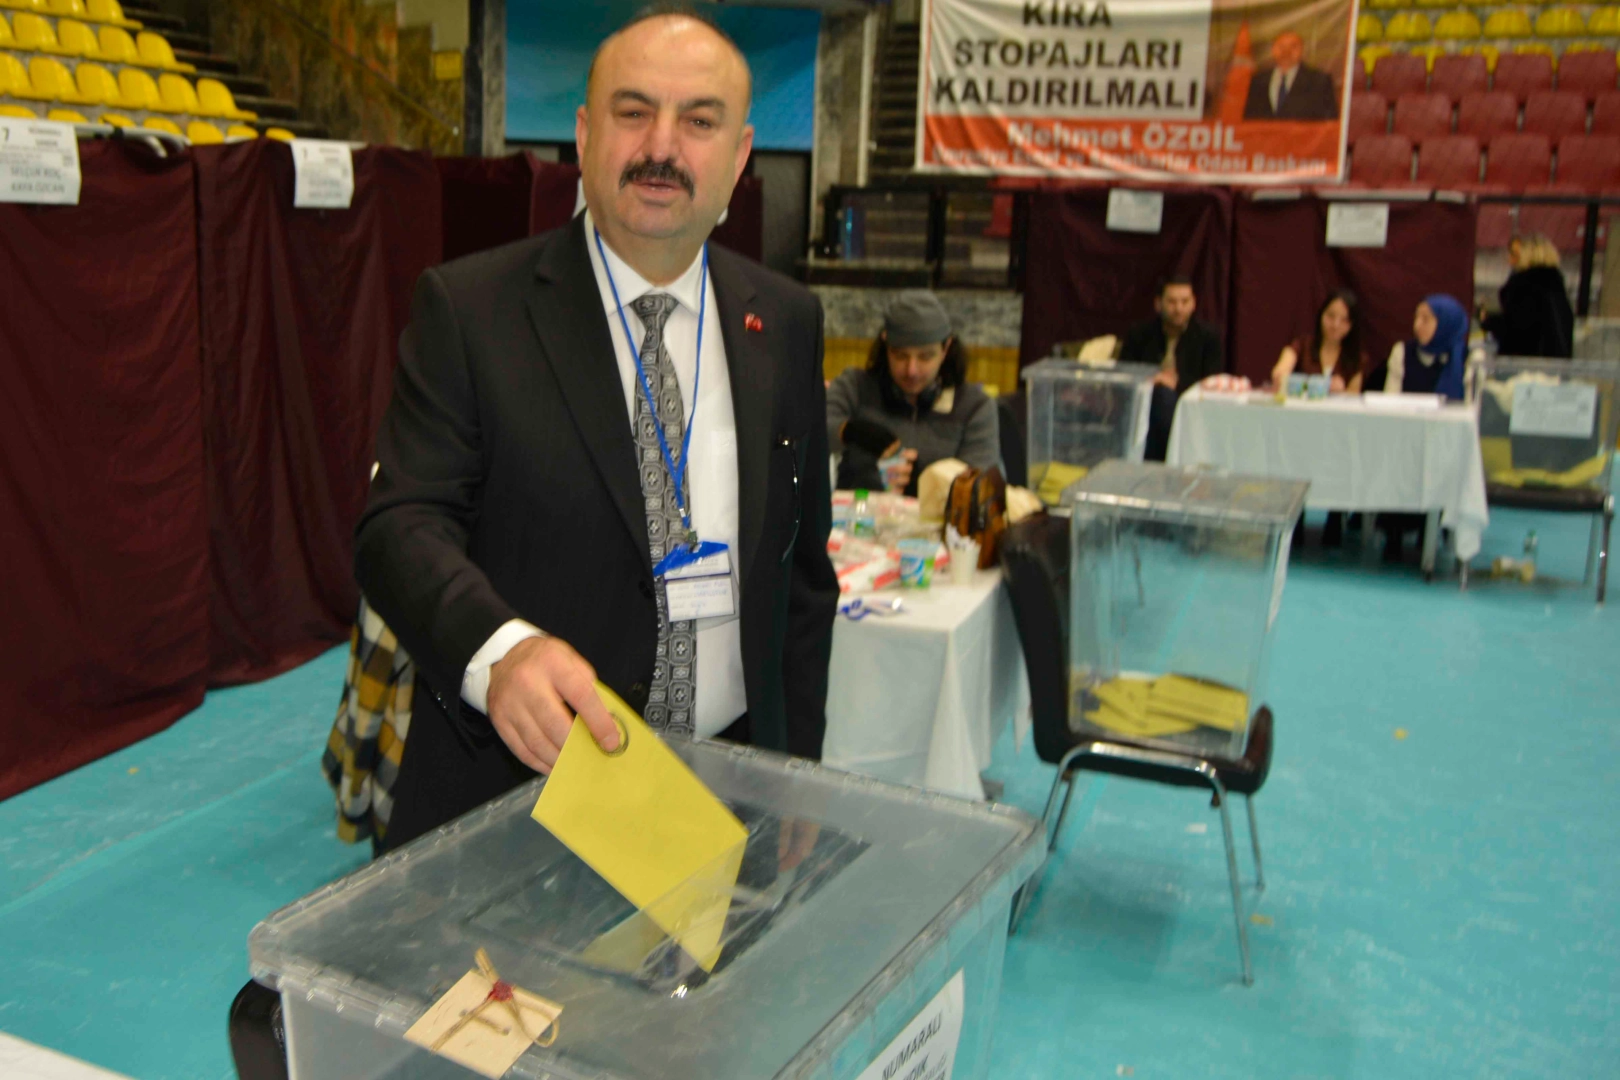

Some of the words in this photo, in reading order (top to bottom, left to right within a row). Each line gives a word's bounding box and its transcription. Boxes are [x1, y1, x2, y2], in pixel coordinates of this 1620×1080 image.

[954, 38, 1182, 69] STOPAJLARI
[934, 76, 1198, 109] KALDIRILMALI
[1007, 121, 1132, 150] Mehmet
[1142, 121, 1243, 152] ÖZDİL
